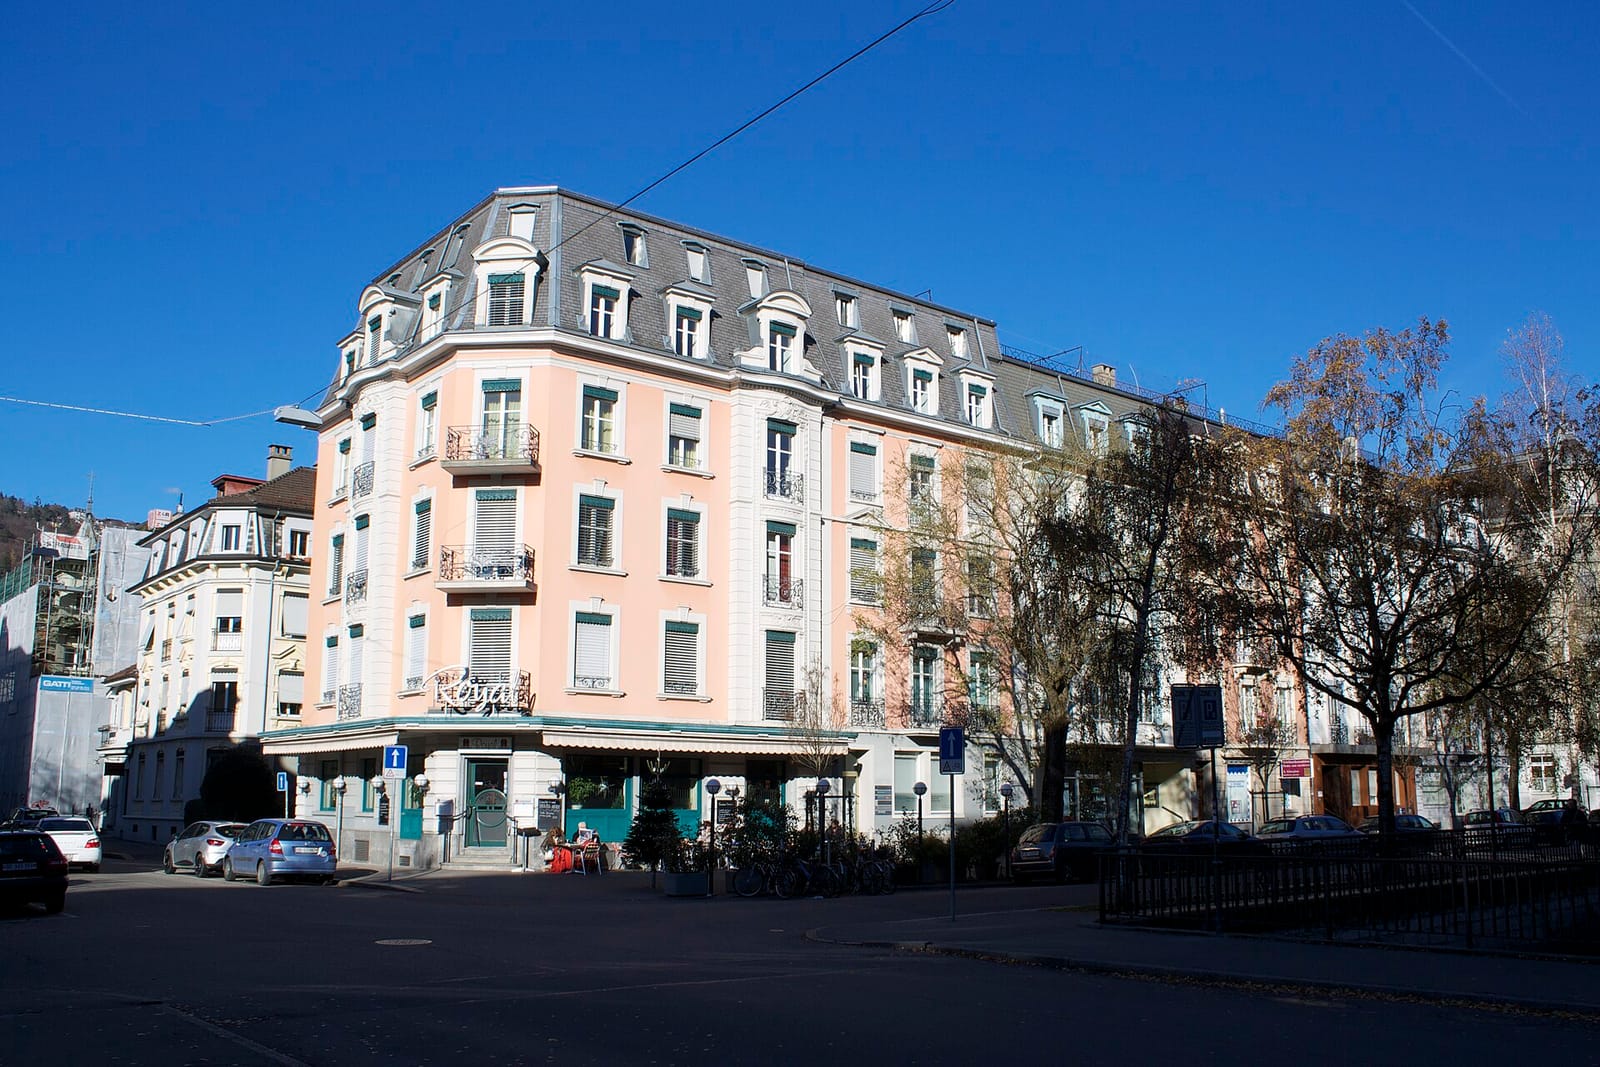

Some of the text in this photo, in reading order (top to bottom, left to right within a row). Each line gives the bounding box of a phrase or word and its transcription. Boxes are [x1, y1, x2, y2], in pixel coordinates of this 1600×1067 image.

[43, 680, 72, 688] GATTI
[421, 664, 521, 712] Royal
[1206, 702, 1213, 718] P
